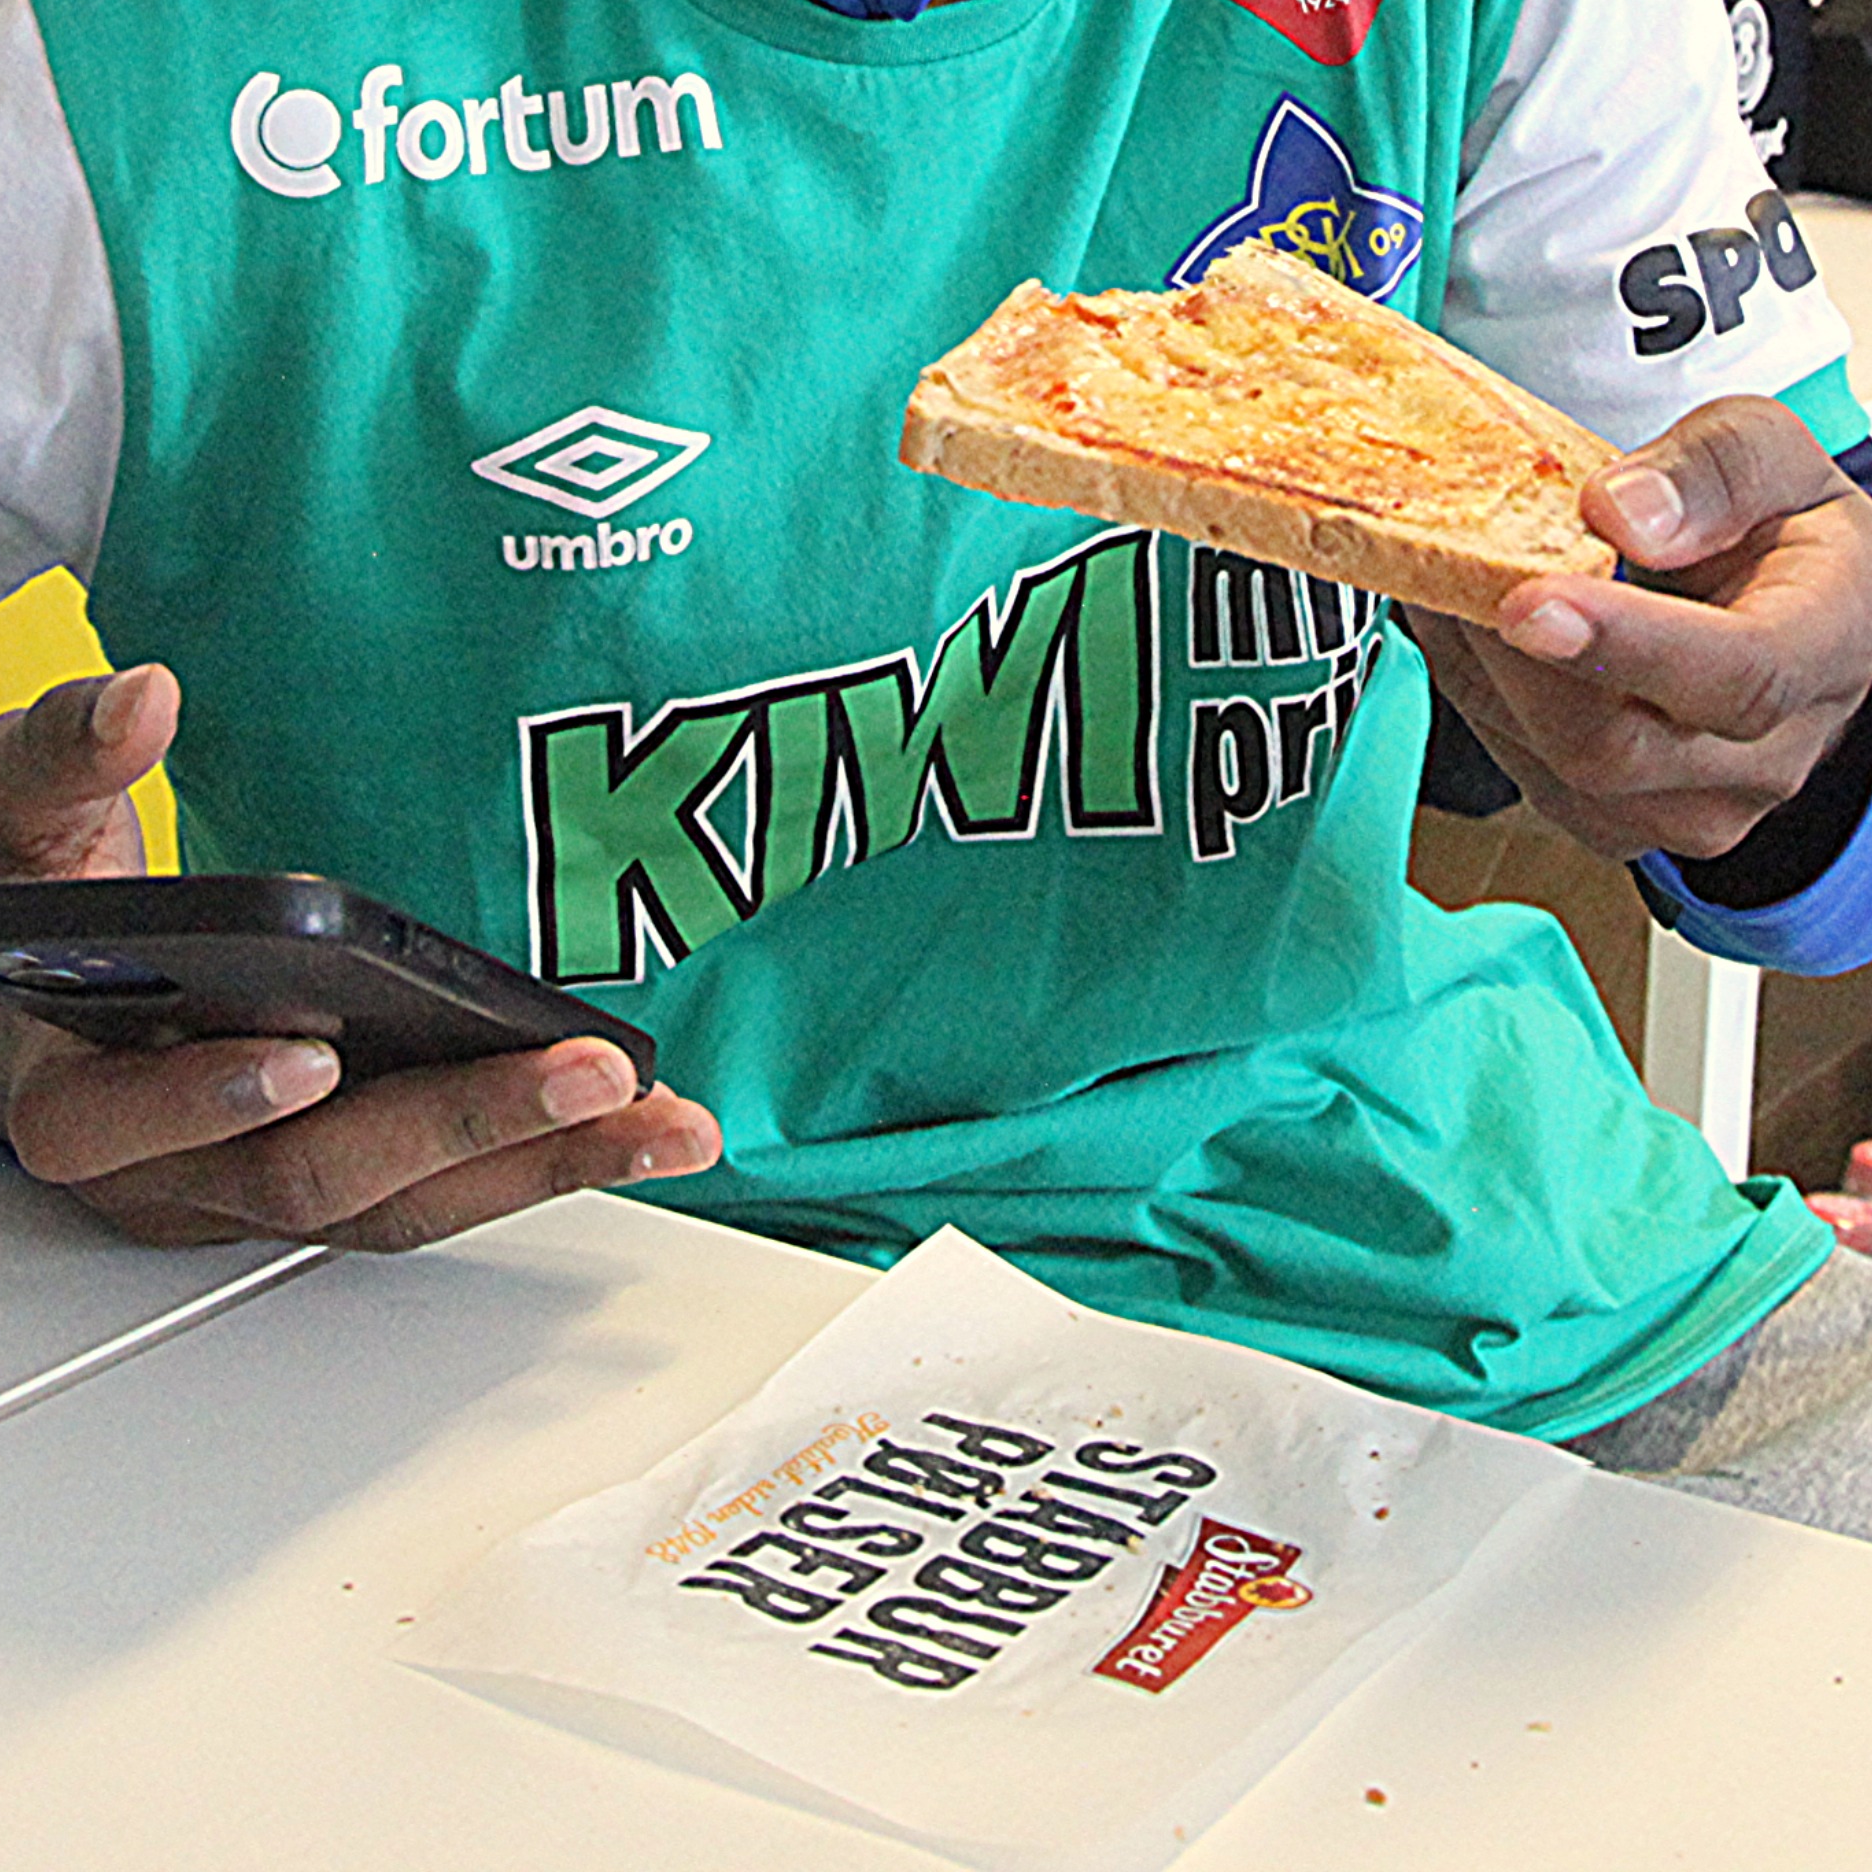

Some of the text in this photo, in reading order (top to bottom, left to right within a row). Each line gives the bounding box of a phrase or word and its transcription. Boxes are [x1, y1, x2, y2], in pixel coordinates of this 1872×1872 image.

[352, 63, 723, 185] fortum
[1368, 222, 1406, 256] 09
[502, 517, 694, 571] umbro
[518, 524, 1164, 988] KIWI
[644, 1518, 718, 1565] 1948
[678, 1411, 1056, 1625] PØLSER
[705, 1478, 777, 1524] siden
[808, 1439, 1218, 1691] STABBUR
[1115, 1534, 1281, 1678] Stabburet
